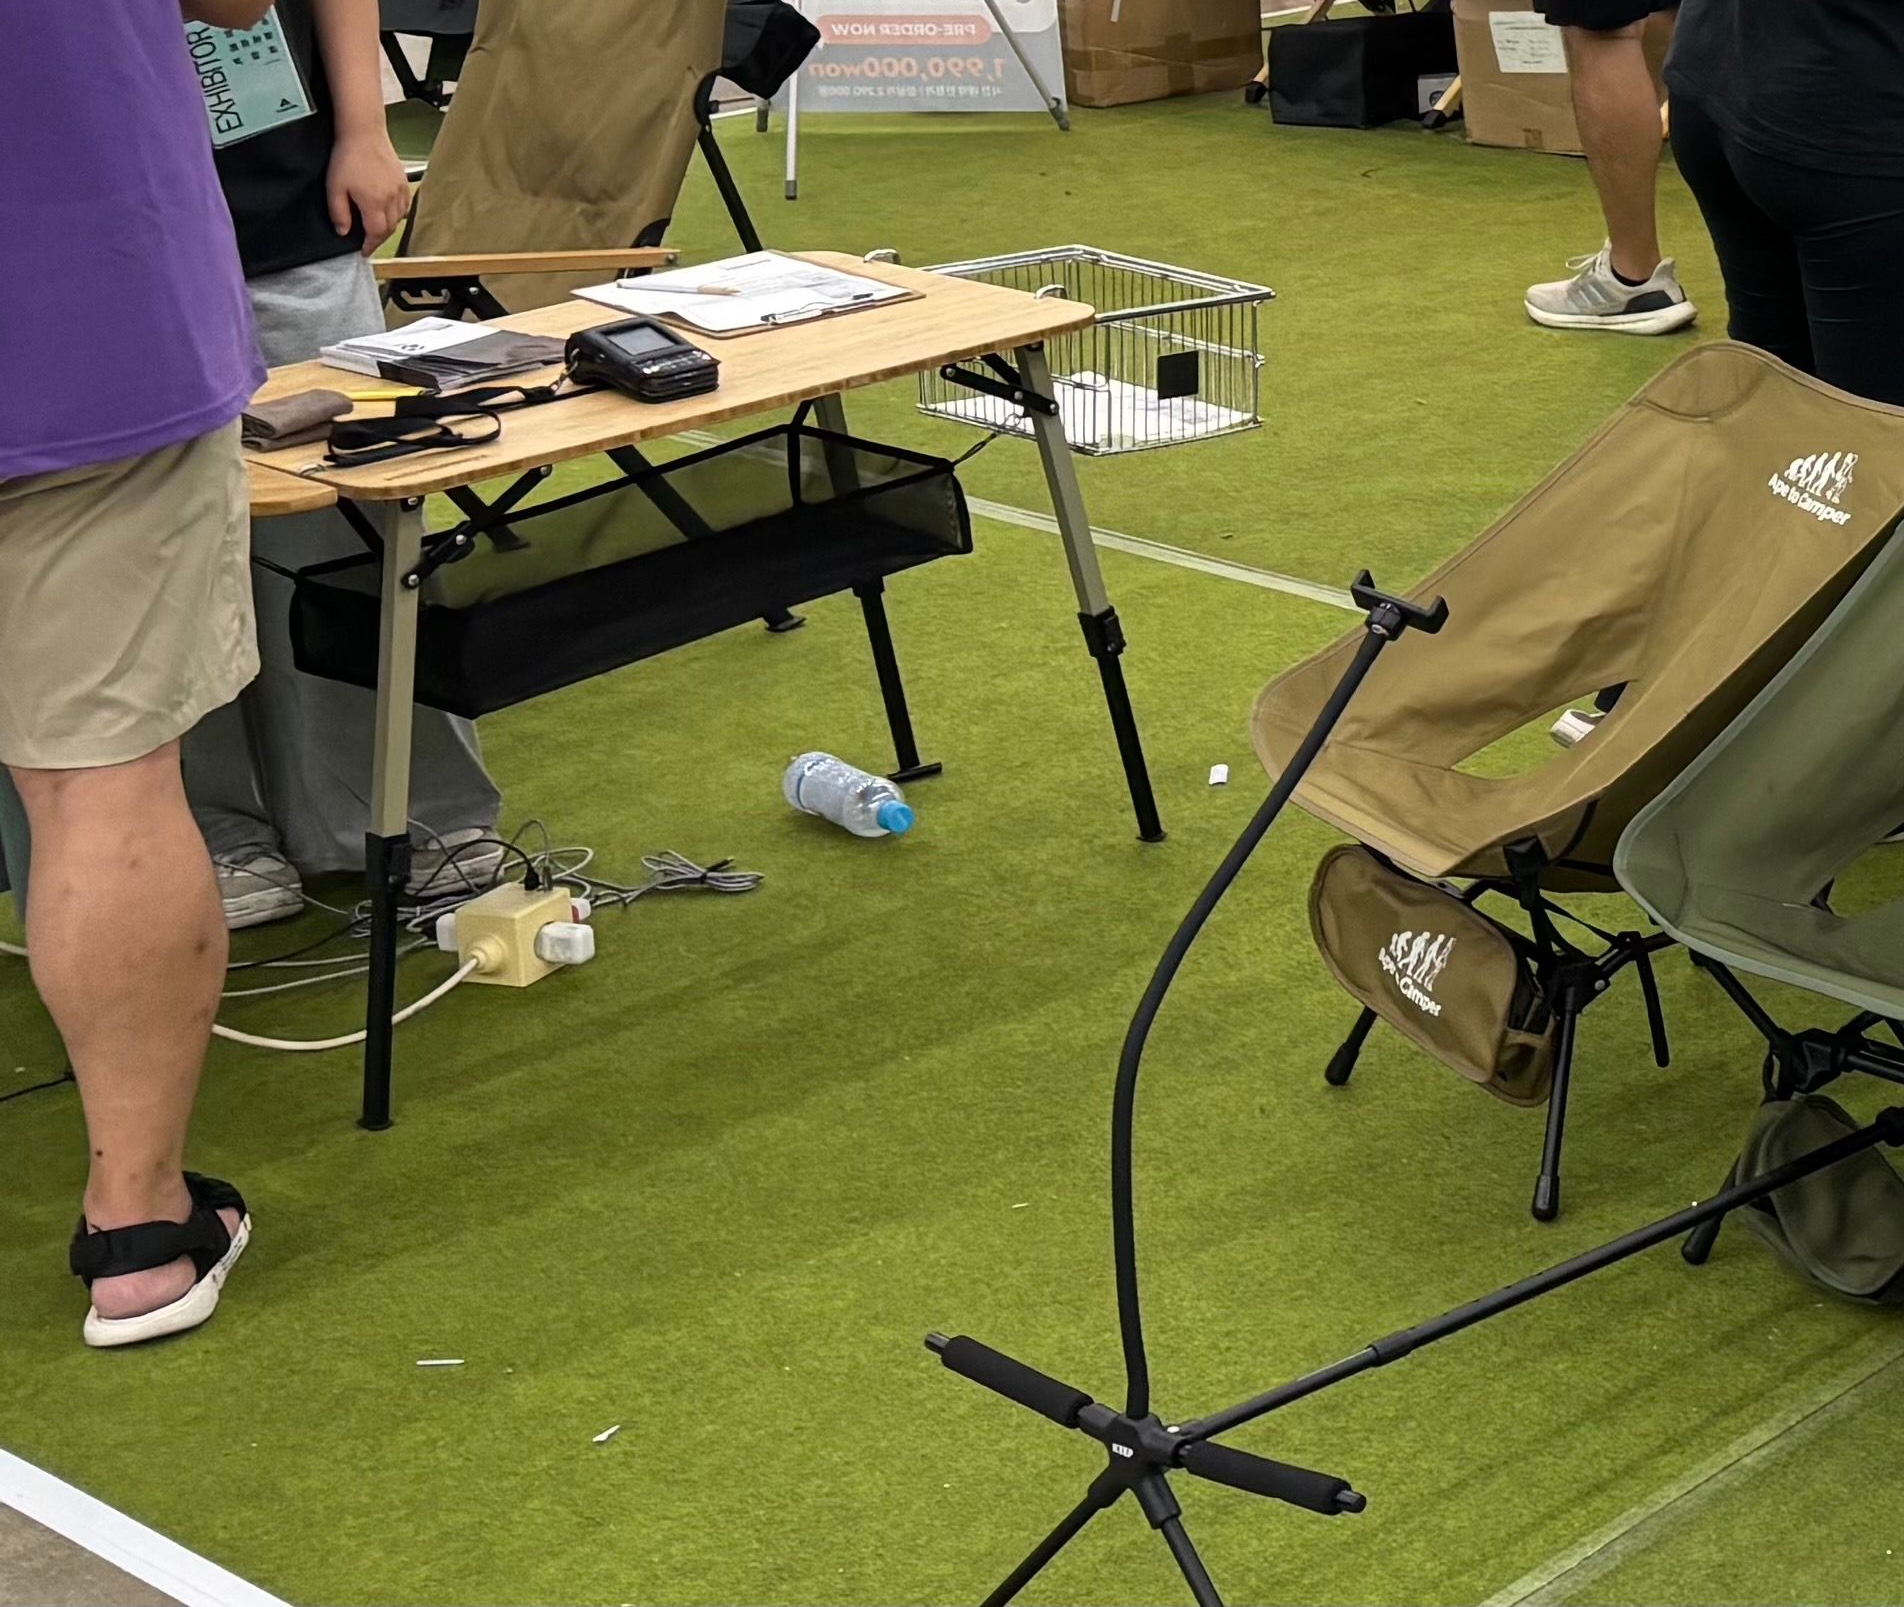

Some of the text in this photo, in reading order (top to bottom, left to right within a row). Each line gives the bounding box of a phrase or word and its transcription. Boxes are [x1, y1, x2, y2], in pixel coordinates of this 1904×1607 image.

[186, 27, 245, 134] EXHIBITOR
[1768, 472, 1852, 526] Ape to Camper
